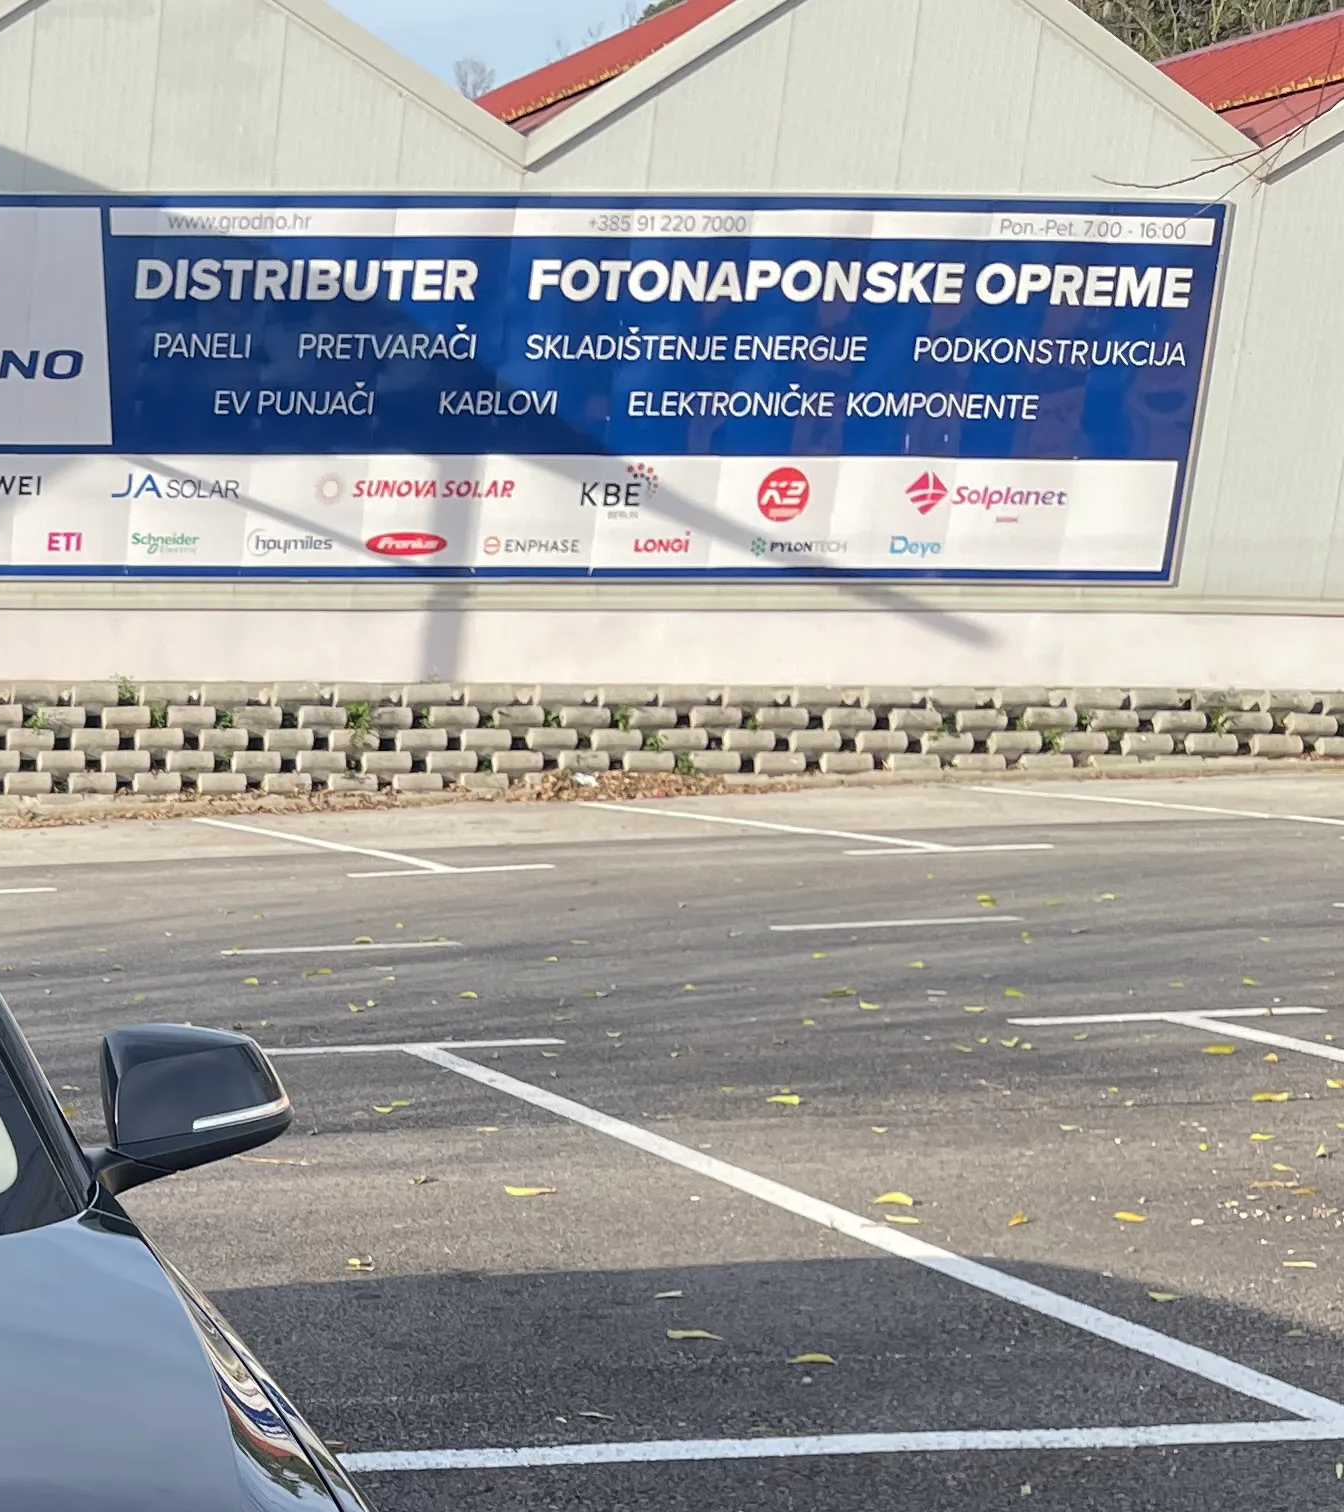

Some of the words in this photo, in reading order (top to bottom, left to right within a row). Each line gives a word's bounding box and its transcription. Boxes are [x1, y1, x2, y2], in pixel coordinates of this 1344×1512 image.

[167, 212, 312, 234] www.grodno.hr
[589, 215, 631, 232] +385
[637, 215, 655, 232] 91
[660, 215, 696, 232] 220
[702, 215, 747, 232] 7000
[134, 258, 479, 301] DISTRIBUTER
[528, 258, 967, 304] FOTONAPONSKE
[975, 261, 1195, 308] OPREME
[153, 332, 252, 359] PANELI
[298, 323, 478, 360] PRETVARAČI
[525, 326, 728, 362] SKLADIŠTENJE
[733, 334, 869, 362] ENERGIJE
[913, 336, 1187, 367] PODKONSTRUKCIJA
[213, 389, 251, 416] EV
[257, 380, 375, 416] PUNJAČI
[438, 389, 558, 417] KABLOVI
[628, 383, 835, 417] ELEKTRONIČKE
[846, 390, 1040, 420] KOMPONENTE
[111, 473, 162, 499] JA
[166, 479, 240, 499] SOLAR
[352, 479, 438, 499] SUNOVA
[442, 479, 516, 498] SOLAR
[580, 481, 642, 507] KBE
[951, 485, 1068, 511] Solplanet
[47, 532, 83, 552] ETI
[131, 532, 200, 554] Schneider
[255, 535, 333, 554] hoymiles
[504, 538, 580, 554] ENPHASE
